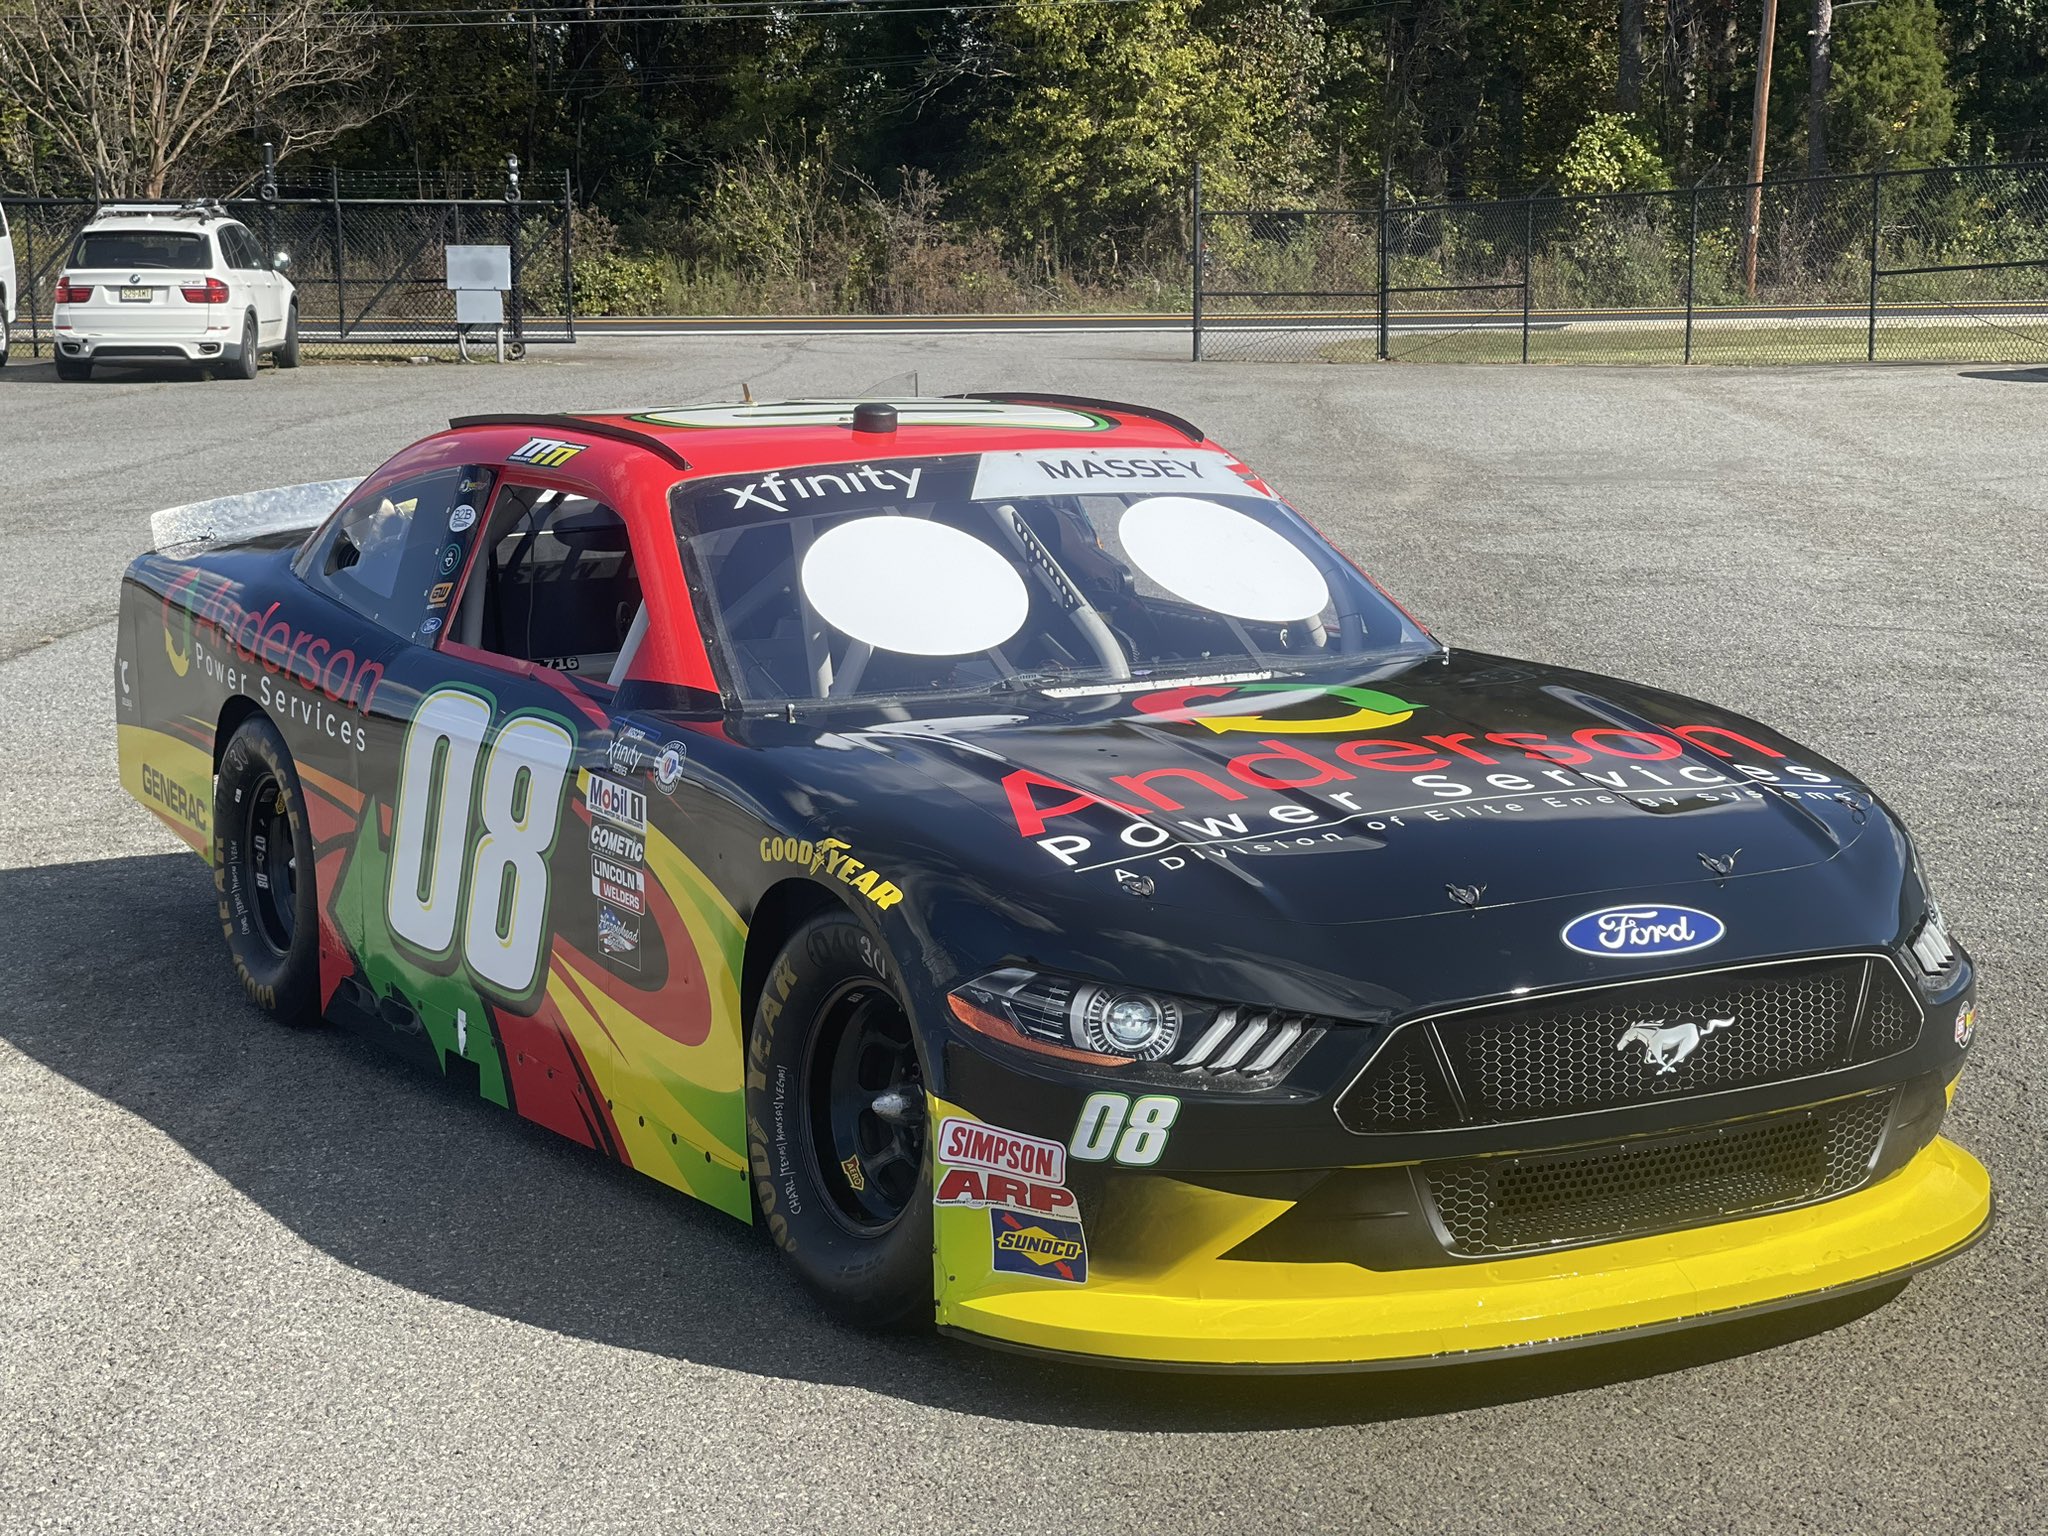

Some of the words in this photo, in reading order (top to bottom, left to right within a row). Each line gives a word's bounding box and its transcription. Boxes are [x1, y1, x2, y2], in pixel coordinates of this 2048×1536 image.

[722, 464, 923, 512] xfinity
[1037, 458, 1206, 480] MASSEY
[453, 508, 473, 520] B2B
[194, 579, 385, 718] Anderson
[195, 641, 248, 696] Power
[260, 675, 367, 752] Services
[606, 737, 643, 773] xfinity
[612, 763, 628, 777] SERIES
[142, 763, 207, 832] GENERAC
[590, 776, 628, 817] Mobil
[1000, 723, 1788, 838] Anderson
[1036, 790, 1362, 866] Power
[1411, 764, 1832, 798] Services
[386, 686, 575, 993] 08
[591, 825, 643, 862] COMETIC
[1114, 867, 1139, 883] A
[1158, 833, 1344, 871] Division
[1367, 815, 1406, 831] of
[1424, 802, 1526, 822] Elite
[1541, 793, 1679, 809] Energy
[594, 859, 635, 891] LINCOLN
[603, 882, 640, 910] WELDERS
[1598, 910, 1696, 949] Ford
[1069, 1093, 1181, 1165] 08
[947, 1126, 1054, 1177] SIMPSON
[846, 1161, 862, 1187] AERO
[936, 1169, 1075, 1212] ARP
[1000, 1233, 1079, 1259] SUNOCO
